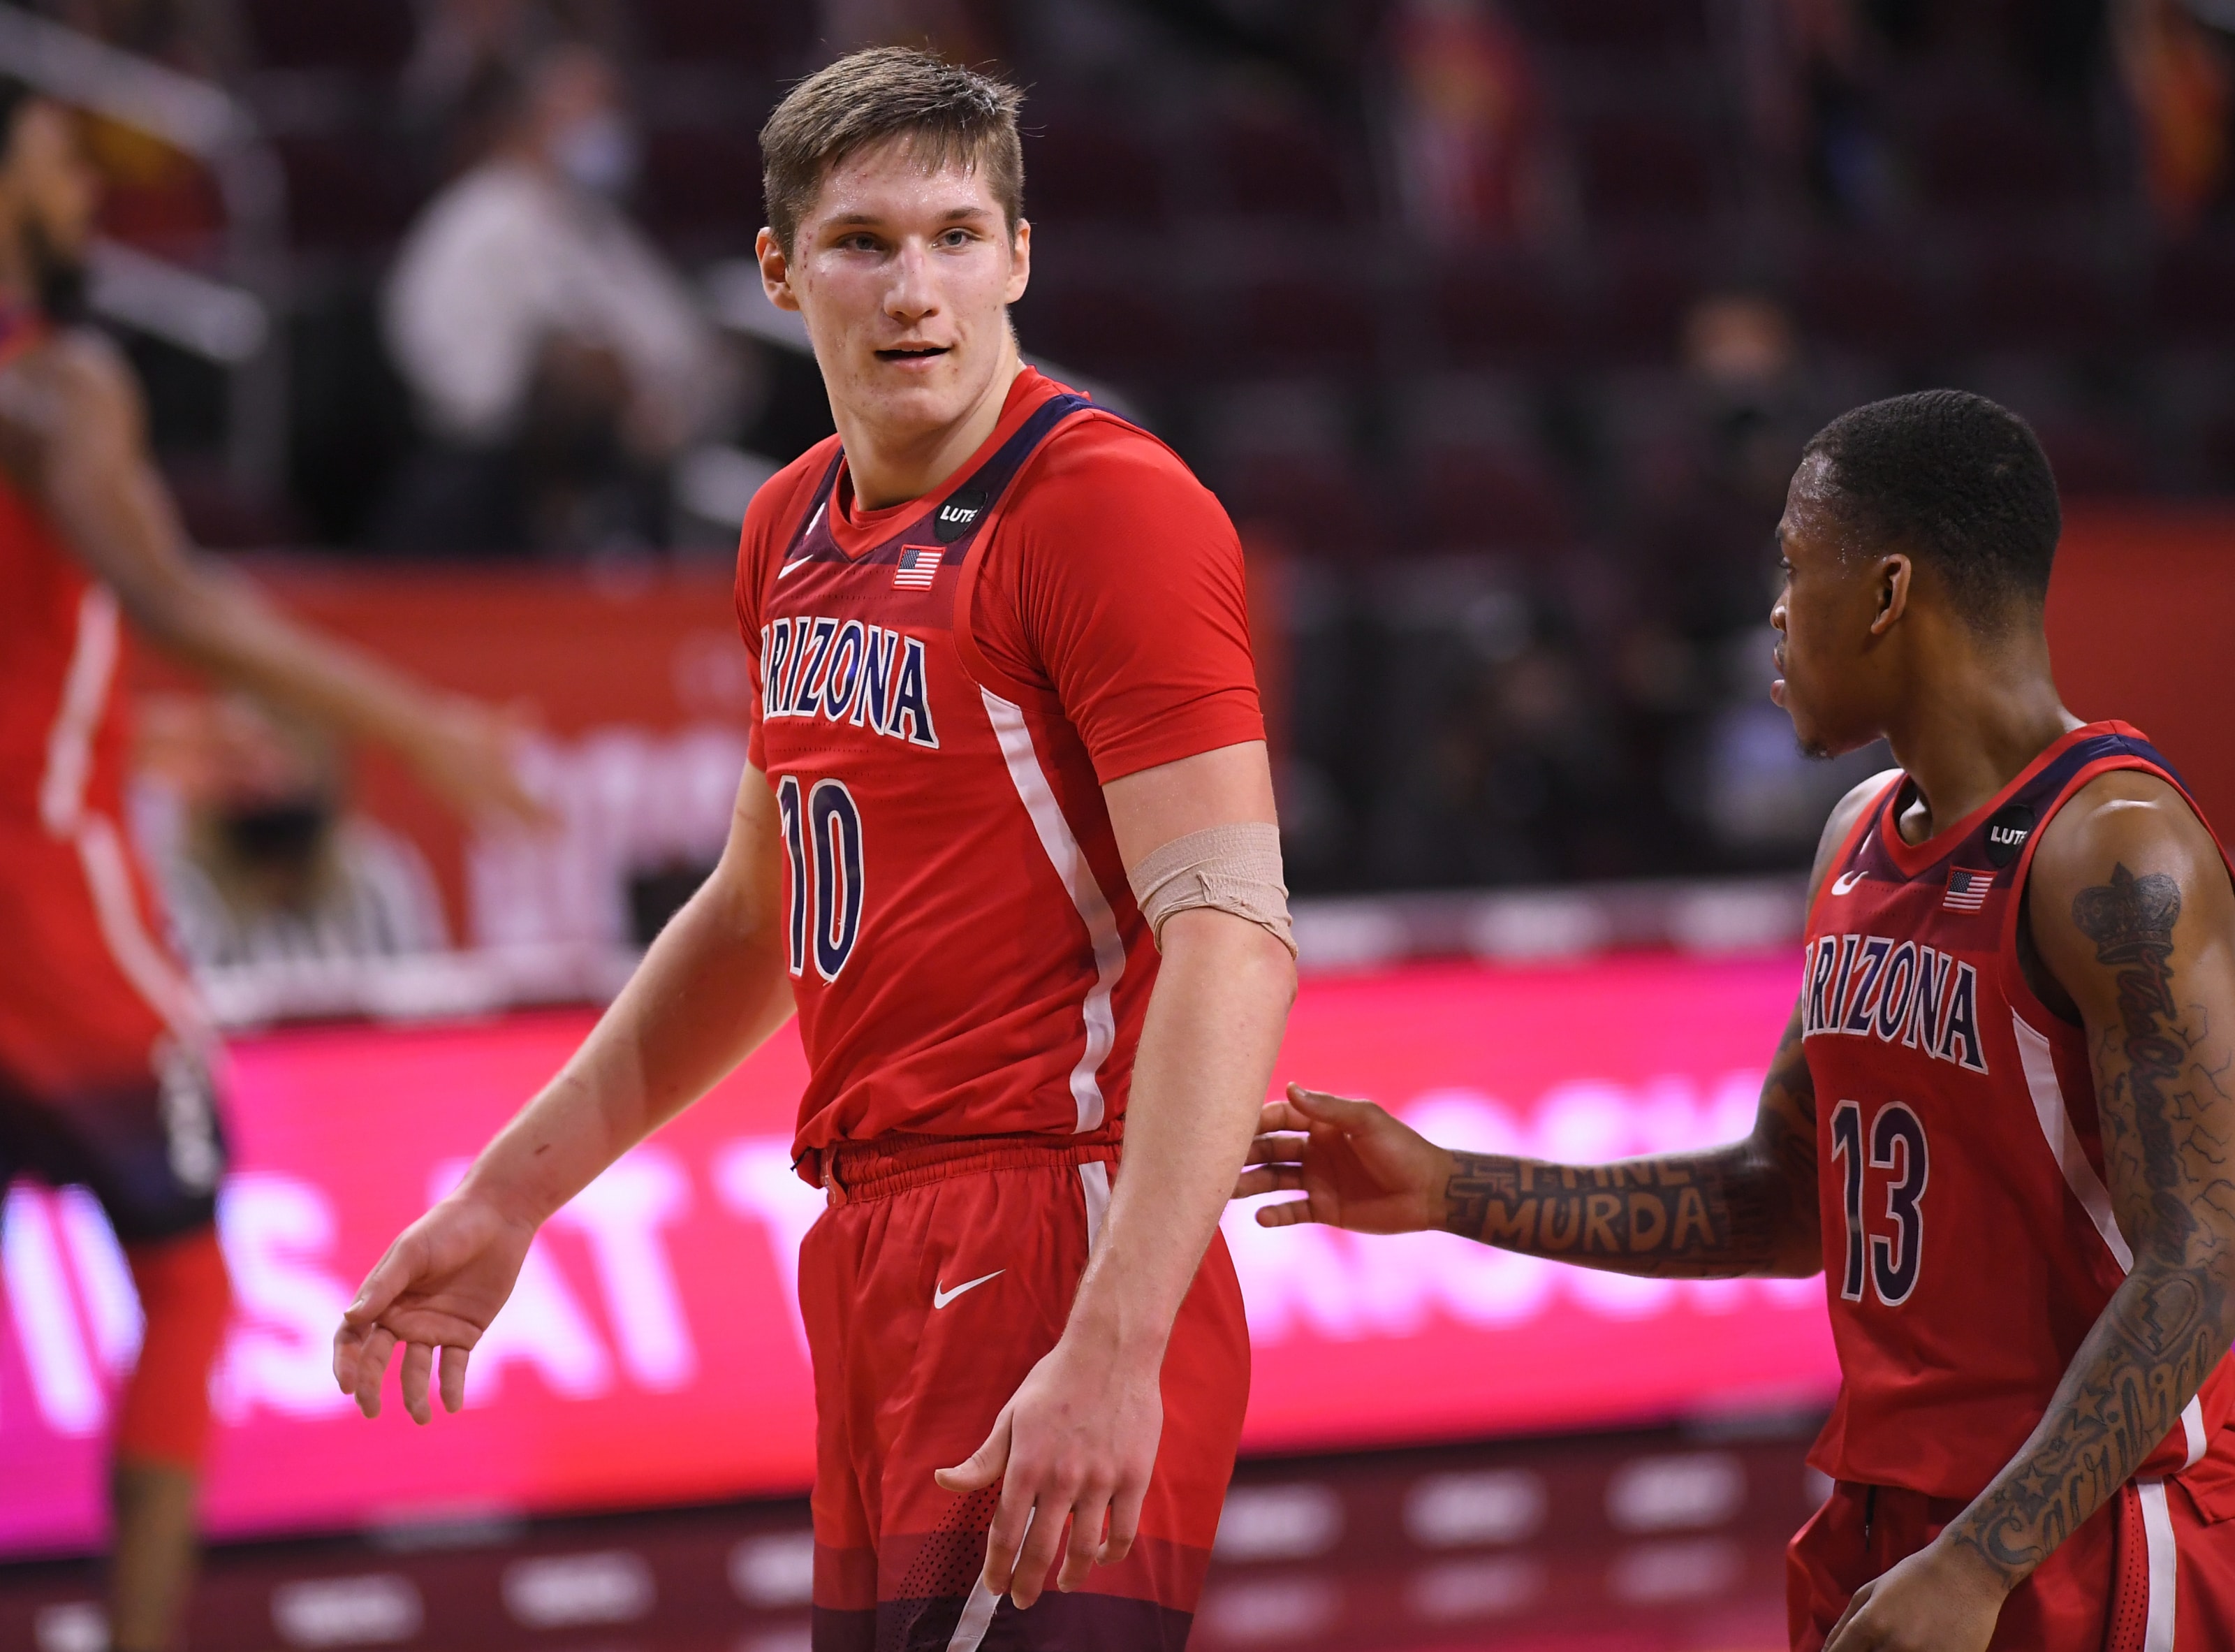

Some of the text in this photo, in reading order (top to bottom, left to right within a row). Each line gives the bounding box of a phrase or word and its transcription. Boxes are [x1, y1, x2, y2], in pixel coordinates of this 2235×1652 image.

[776, 775, 865, 983] 10
[1480, 1187, 1717, 1252] MURDA
[1829, 1099, 1929, 1307] 13
